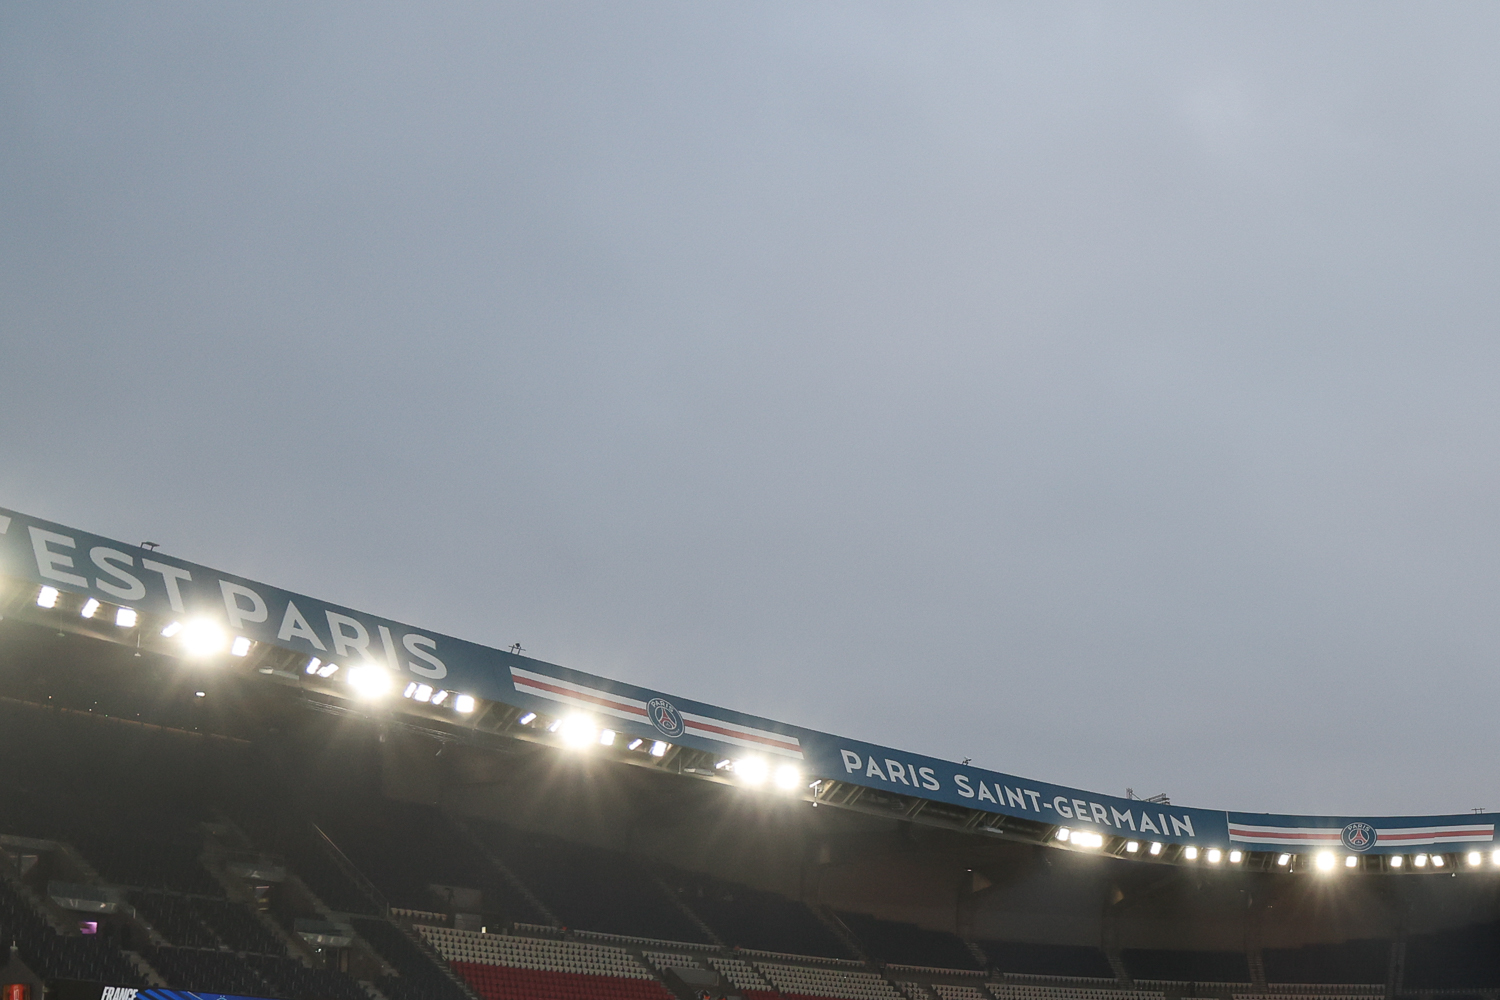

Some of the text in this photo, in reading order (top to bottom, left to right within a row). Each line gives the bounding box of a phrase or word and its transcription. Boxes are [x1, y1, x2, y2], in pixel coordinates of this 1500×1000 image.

[218, 579, 448, 680] PARIS
[840, 748, 1196, 838] PARIS SAINT-GERMAIN
